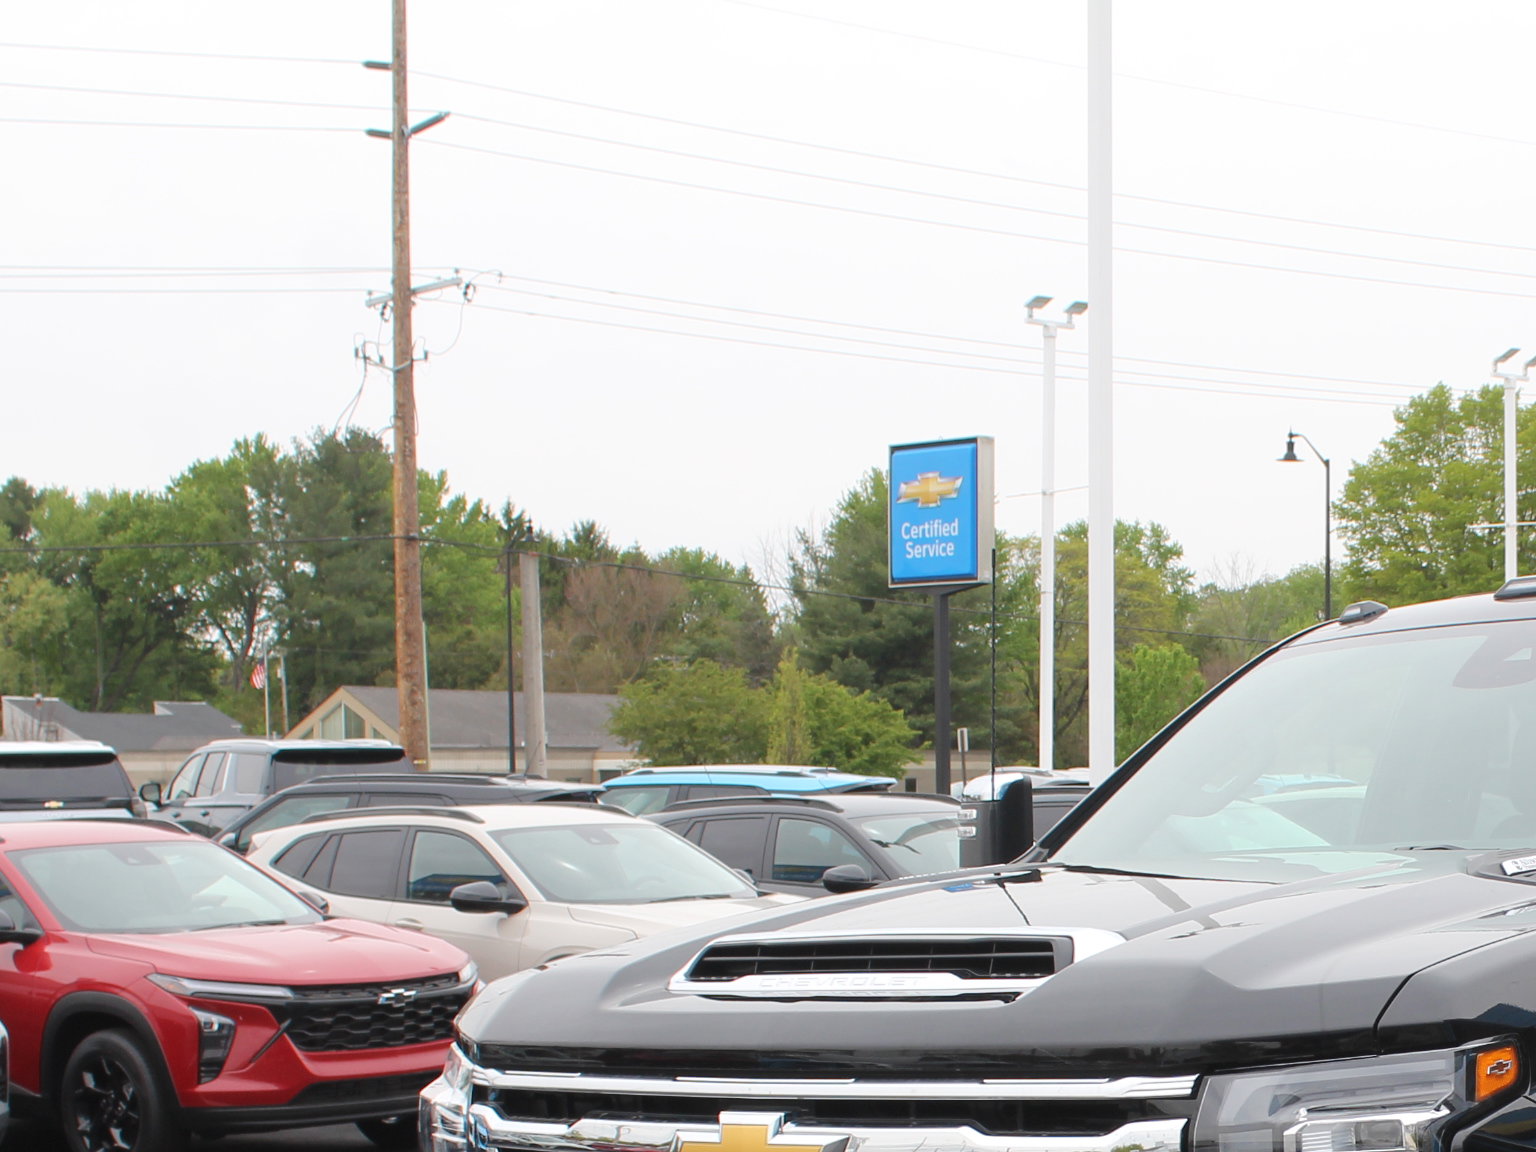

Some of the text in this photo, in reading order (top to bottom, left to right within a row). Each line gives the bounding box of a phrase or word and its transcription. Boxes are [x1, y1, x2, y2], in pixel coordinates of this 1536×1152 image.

[901, 518, 959, 539] Certified
[905, 540, 955, 559] Service
[759, 976, 928, 988] CHEVROLET
